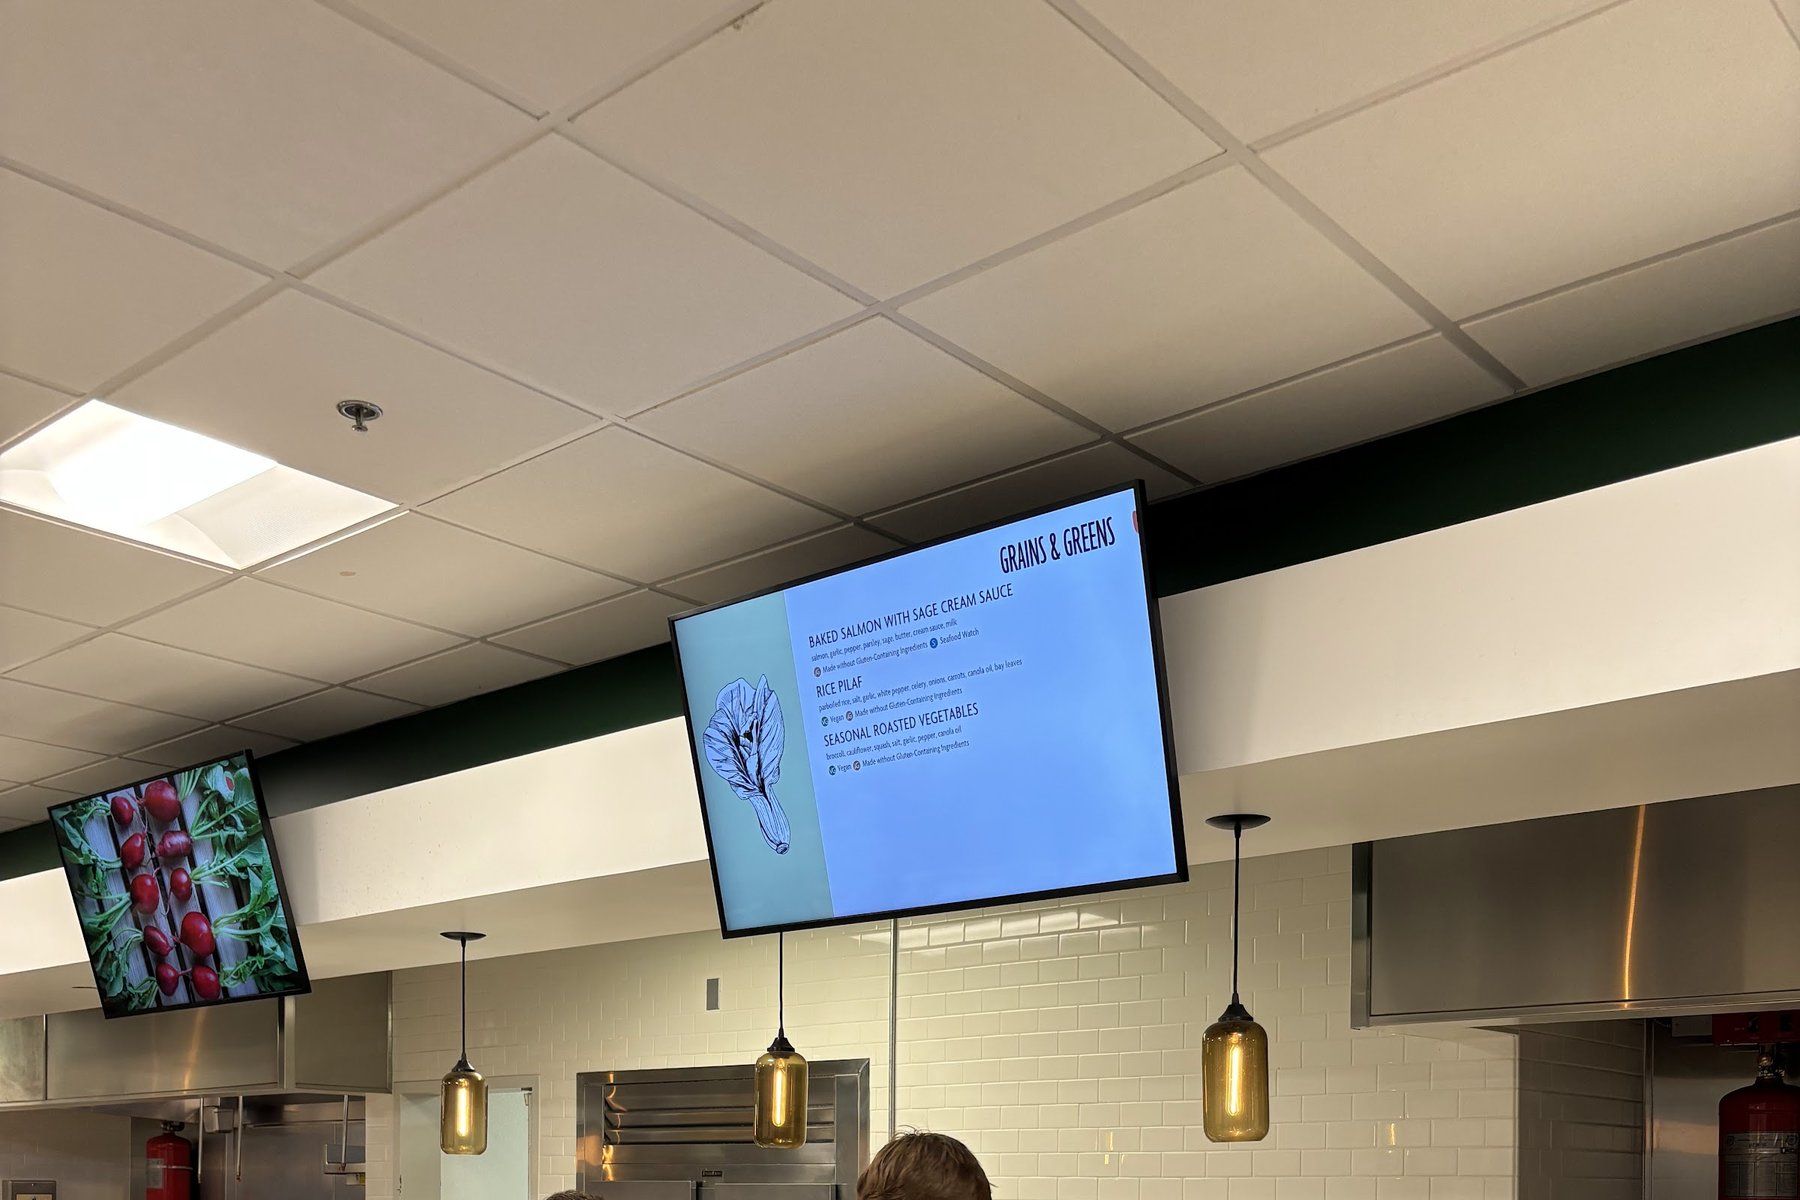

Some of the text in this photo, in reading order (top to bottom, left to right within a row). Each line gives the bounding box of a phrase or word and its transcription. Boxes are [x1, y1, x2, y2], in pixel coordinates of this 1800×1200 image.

[1000, 517, 1115, 573] GRAINS & GREENS
[809, 583, 1013, 648] BAKED SALMON WITH SAGE CREAM SAUCE
[811, 618, 958, 662] salmon, garlic, pepper, parsley, sage, butter, cream sauce, milk
[823, 665, 836, 673] Made
[837, 660, 855, 670] without
[856, 648, 899, 665] Gluten-Containing
[900, 641, 928, 655] Ingredients
[940, 632, 961, 644] Seafood
[962, 628, 979, 639] Watch
[816, 676, 862, 698] RICE PILAF
[841, 698, 851, 706] rice,
[852, 695, 862, 704] salt,
[863, 692, 876, 703] garlic,
[877, 688, 891, 698] white
[892, 685, 911, 697] pepper,
[912, 680, 928, 691] celery,
[929, 676, 946, 687] onions,
[947, 671, 967, 682] carrots,
[967, 667, 985, 677] canola
[985, 664, 994, 673] oil,
[994, 662, 1004, 672] bay
[1005, 659, 1022, 669] leaves
[823, 702, 979, 747] SEASONAL ROASTED VEGETABLES
[830, 714, 844, 724] Vegan
[855, 708, 868, 717] Made
[870, 703, 888, 714] without
[889, 693, 933, 710] Gluten-Containing
[934, 687, 962, 700] Ingredients
[826, 750, 846, 761] broccoli,
[846, 745, 873, 757] cauliflower,
[873, 741, 891, 752] squash,
[892, 738, 902, 747] salt,
[903, 736, 916, 746] garlic,
[917, 731, 937, 743] pepper,
[938, 727, 954, 738] canola
[837, 763, 851, 773] Vegan
[862, 758, 876, 767] Made
[877, 754, 895, 764] without
[896, 745, 940, 760] Gluten-Containing
[941, 739, 969, 752] Ingredients
